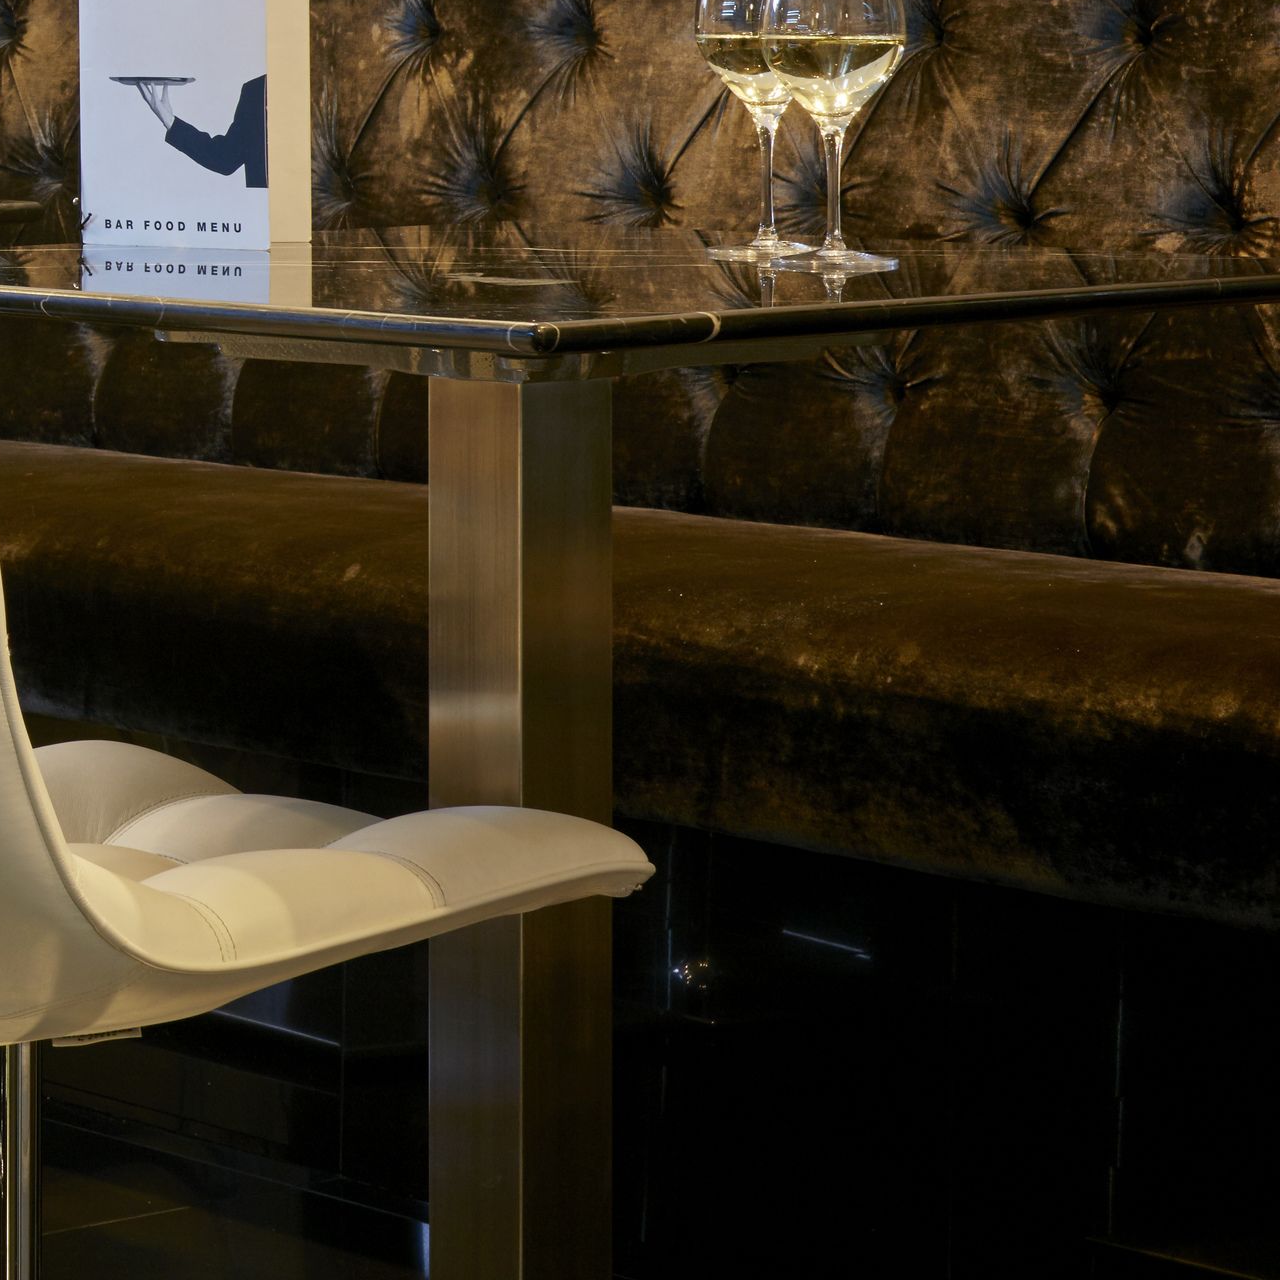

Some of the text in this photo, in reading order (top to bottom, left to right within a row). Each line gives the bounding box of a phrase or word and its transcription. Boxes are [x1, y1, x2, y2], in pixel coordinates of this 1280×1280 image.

[103, 218, 243, 235] BAR FOOD MENU
